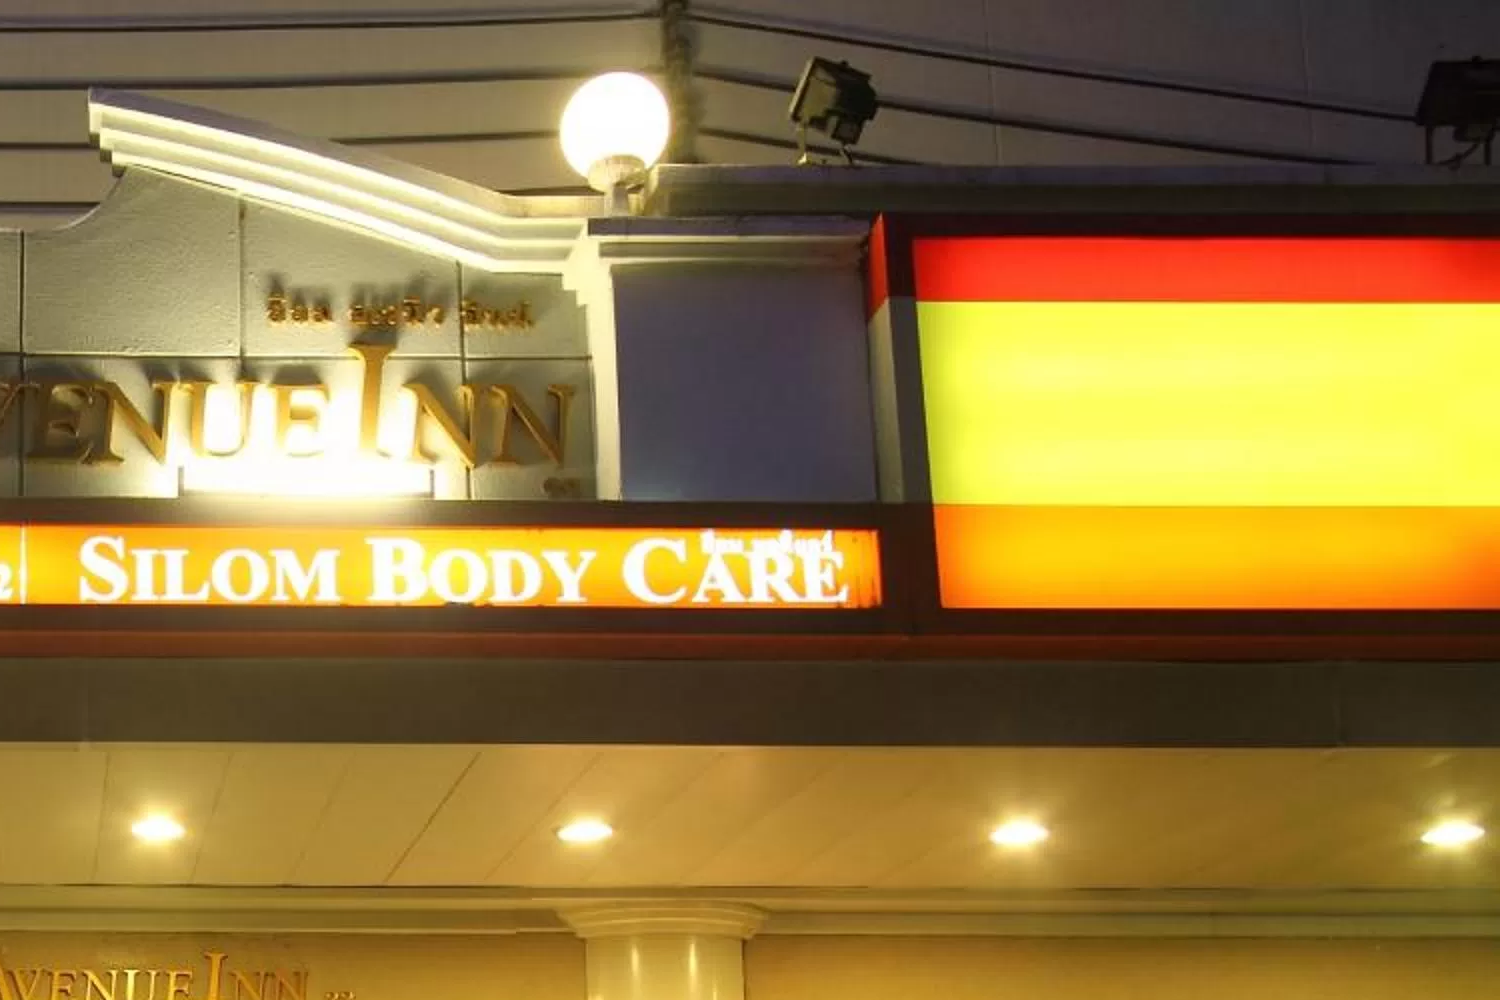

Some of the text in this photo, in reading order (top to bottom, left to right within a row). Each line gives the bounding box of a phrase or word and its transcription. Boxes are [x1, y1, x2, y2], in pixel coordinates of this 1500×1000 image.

[347, 343, 575, 468] INN
[78, 536, 848, 605] SILOM BODY CARE
